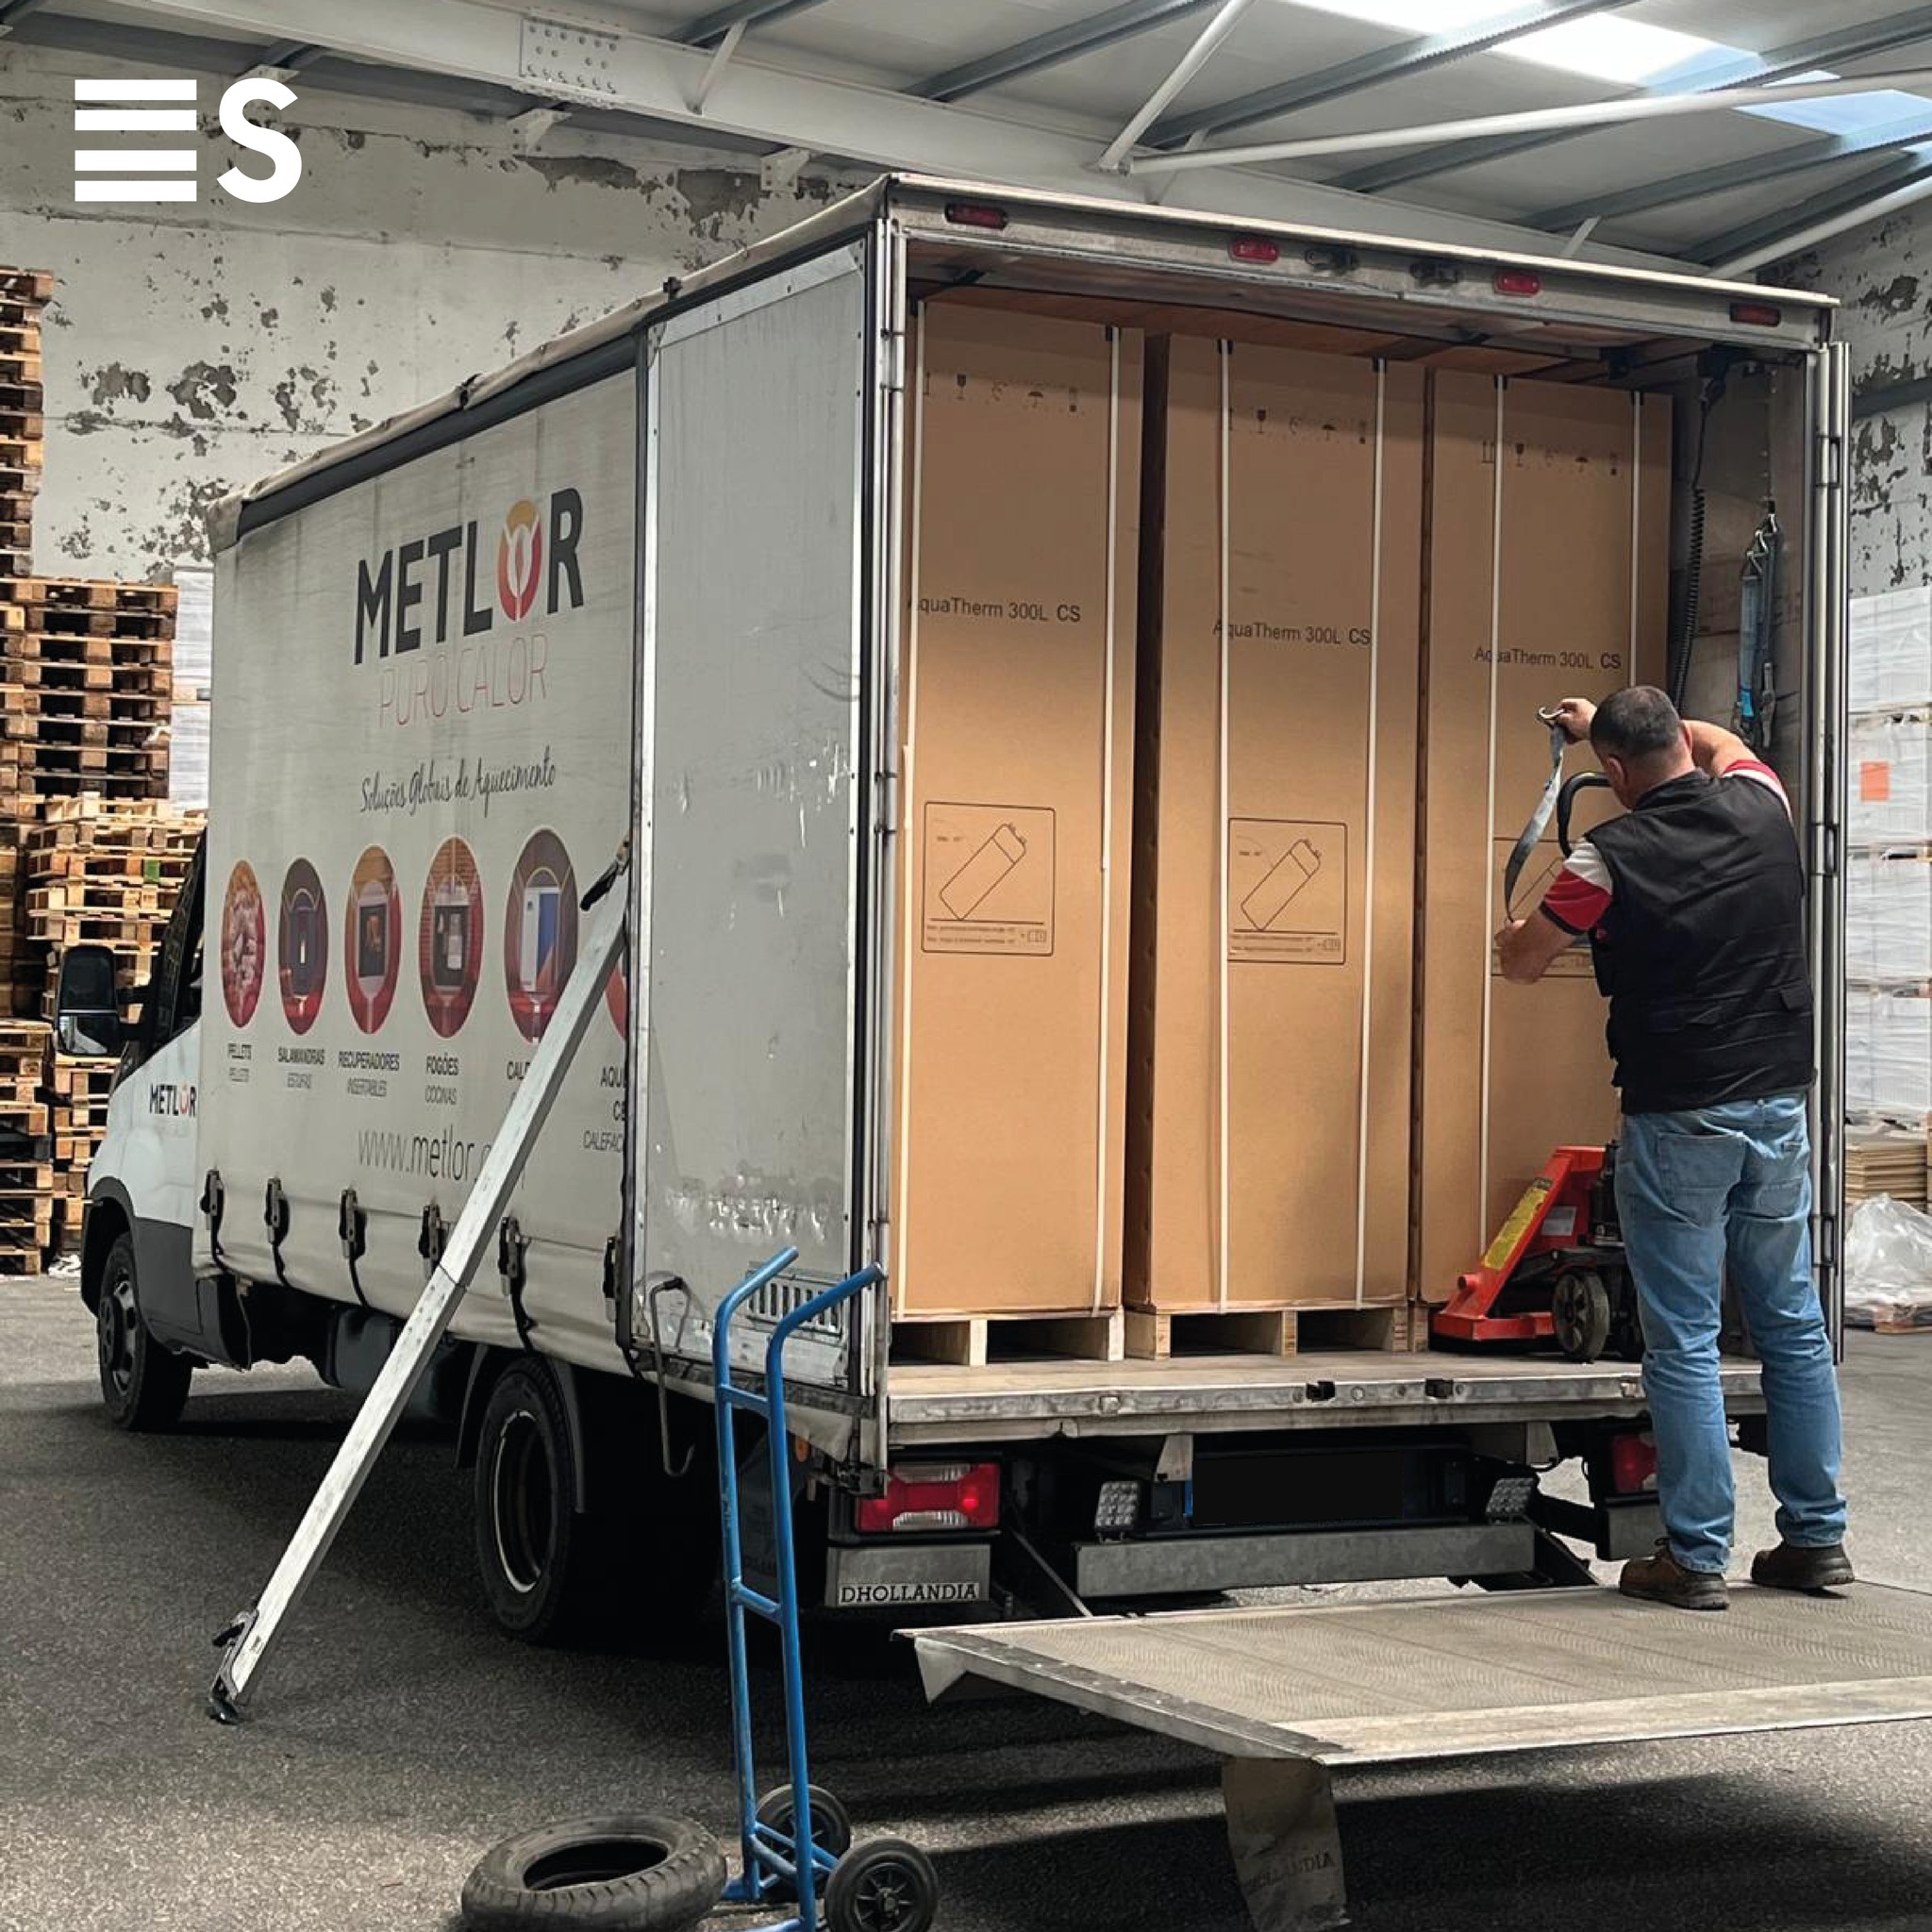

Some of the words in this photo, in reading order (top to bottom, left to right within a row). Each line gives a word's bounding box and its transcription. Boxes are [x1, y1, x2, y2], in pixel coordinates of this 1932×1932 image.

[354, 487, 584, 666] METLOR
[1009, 602, 1048, 623] 300L
[1057, 605, 1081, 623] CS
[1306, 625, 1341, 645] 300L
[1349, 627, 1371, 645] CS
[1560, 651, 1594, 670] 300L
[1600, 651, 1622, 670] CS
[379, 654, 447, 729] PURO
[458, 633, 549, 713] CALOR
[455, 757, 470, 799] de
[470, 744, 557, 819] Aquecimento
[338, 1050, 400, 1072] RECUPERADORES
[426, 1051, 459, 1076] FOGÕES
[149, 1083, 197, 1118] METLOR
[841, 1583, 978, 1604] DHOLLANDIA
